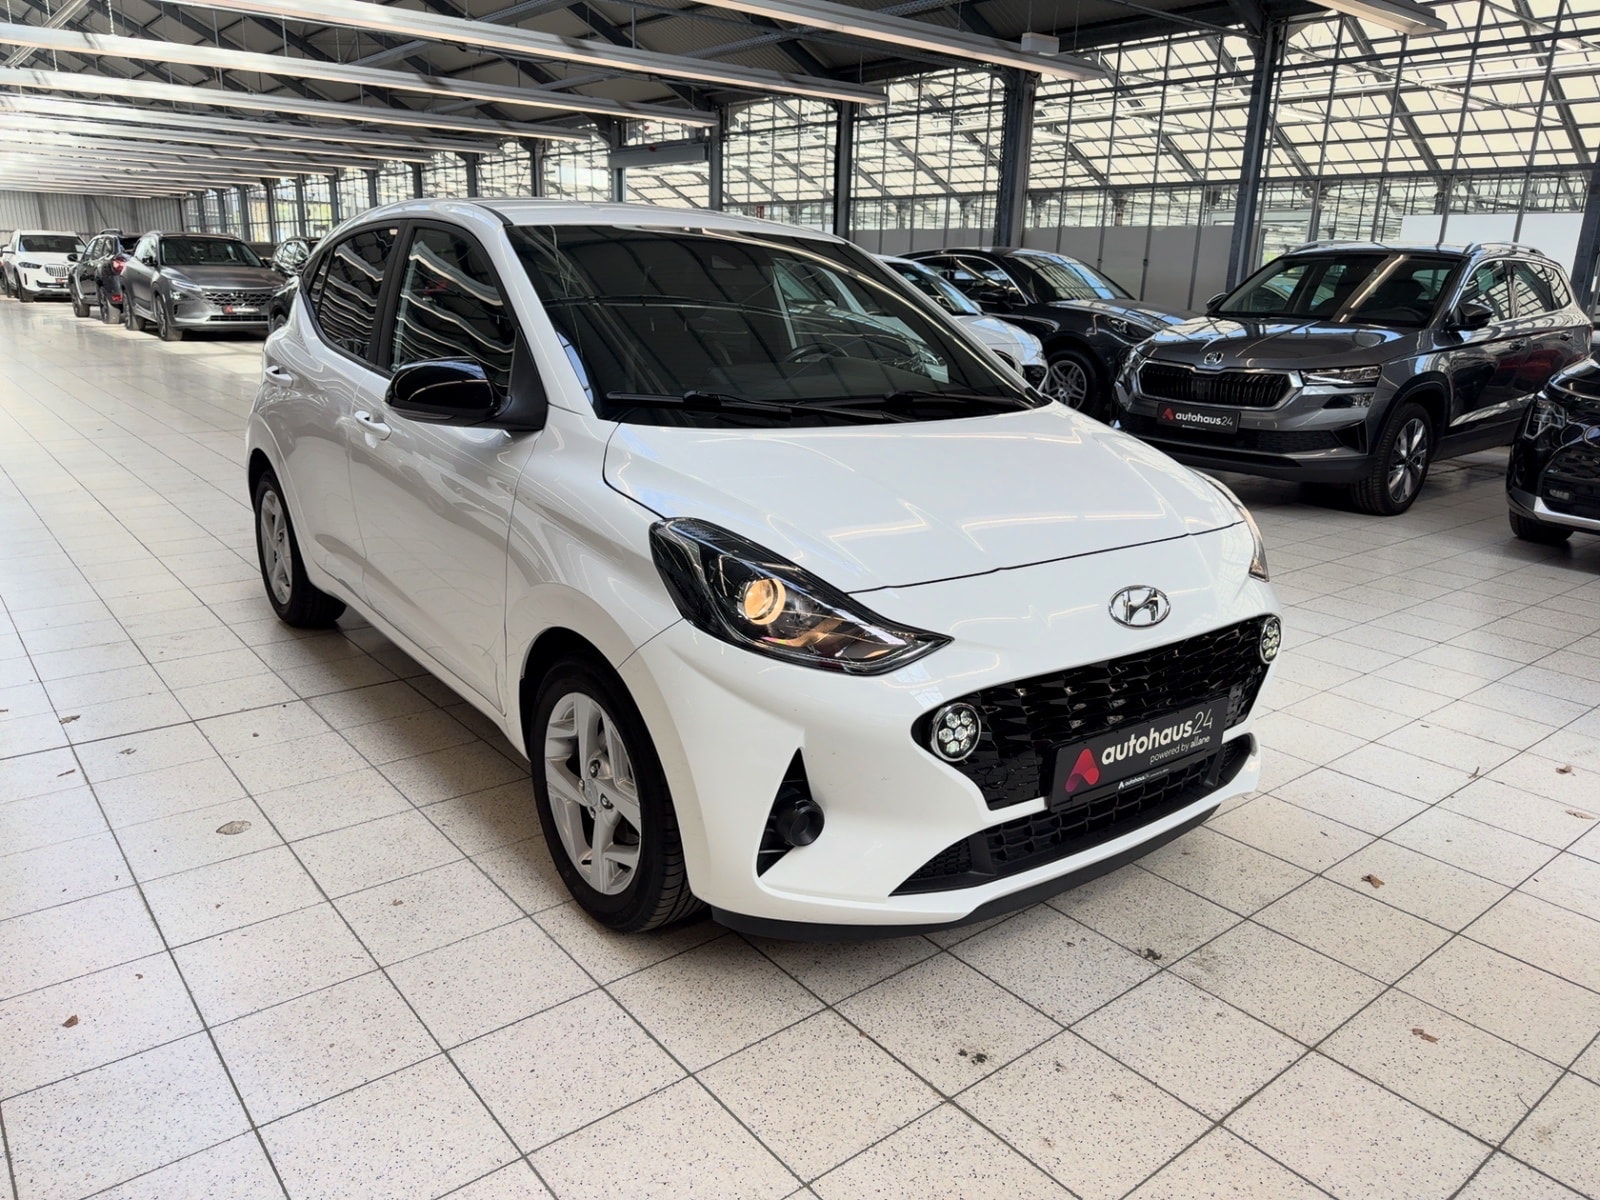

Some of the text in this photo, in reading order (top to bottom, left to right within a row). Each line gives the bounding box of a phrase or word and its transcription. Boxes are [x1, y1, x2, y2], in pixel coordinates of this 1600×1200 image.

[1175, 412, 1233, 426] autohaus24
[1101, 708, 1213, 765] autohaus24
[1149, 736, 1210, 765] powered by allane
